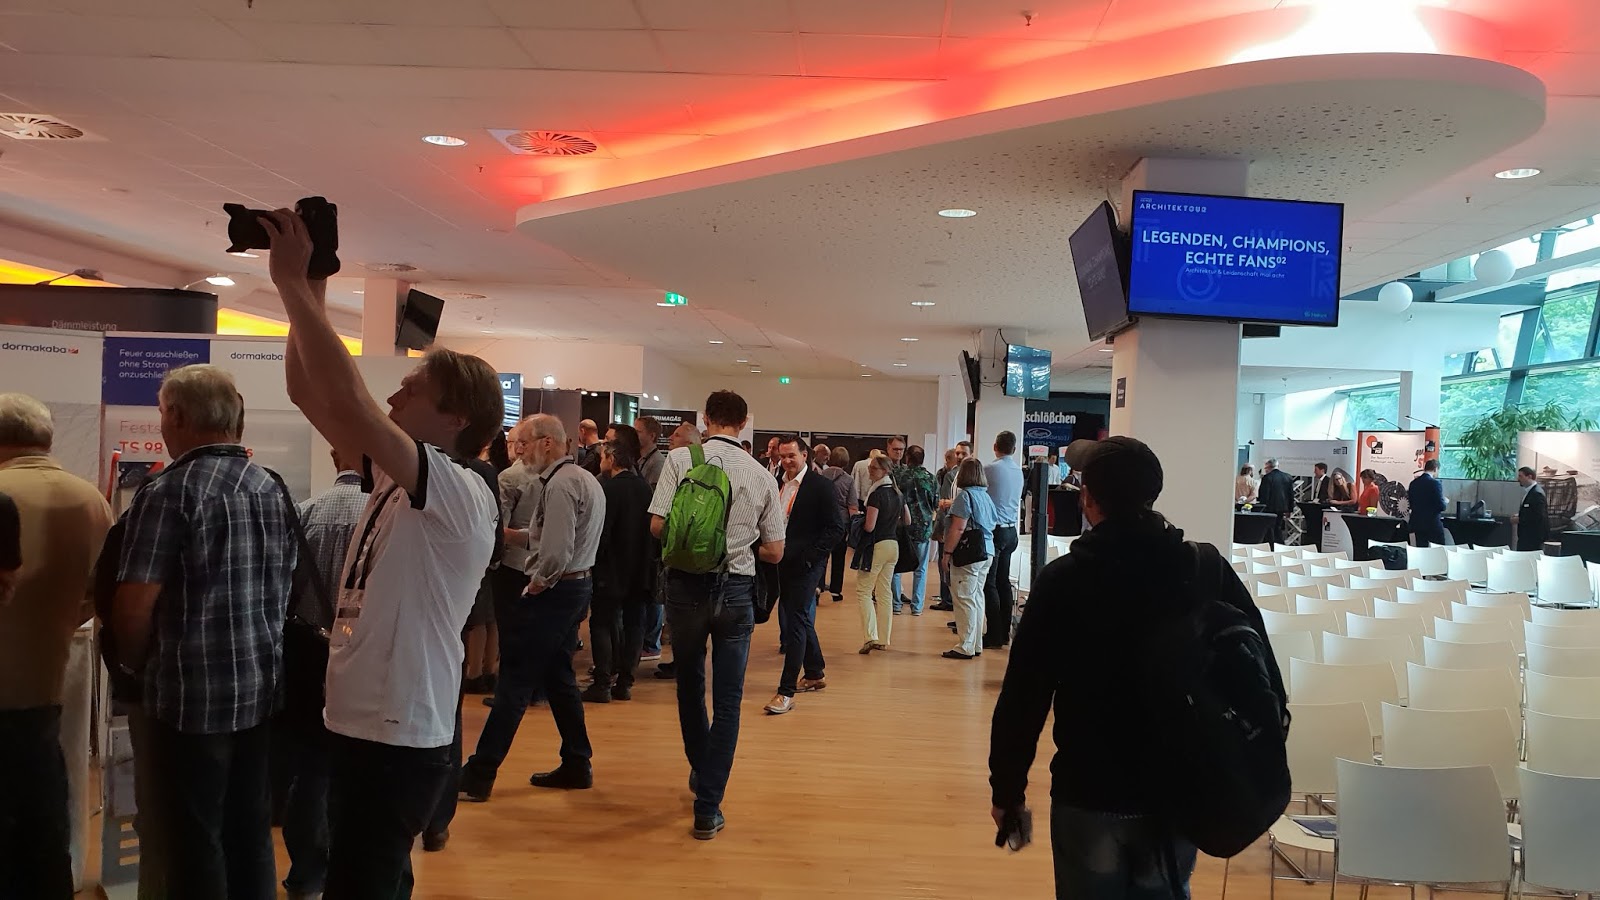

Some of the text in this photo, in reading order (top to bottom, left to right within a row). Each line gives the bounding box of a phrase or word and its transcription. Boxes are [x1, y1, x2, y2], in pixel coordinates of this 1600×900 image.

[1142, 230, 1330, 256] LEGENDEN, CHAMPIONS,
[1185, 251, 1234, 266] ECHTE
[2, 342, 67, 353] dormakaba
[119, 349, 199, 359] Feuer ausschließen
[230, 352, 283, 361] dormakaba
[119, 360, 169, 369] ohne Strom
[120, 420, 161, 434] Fests
[119, 441, 163, 454] TS 98
